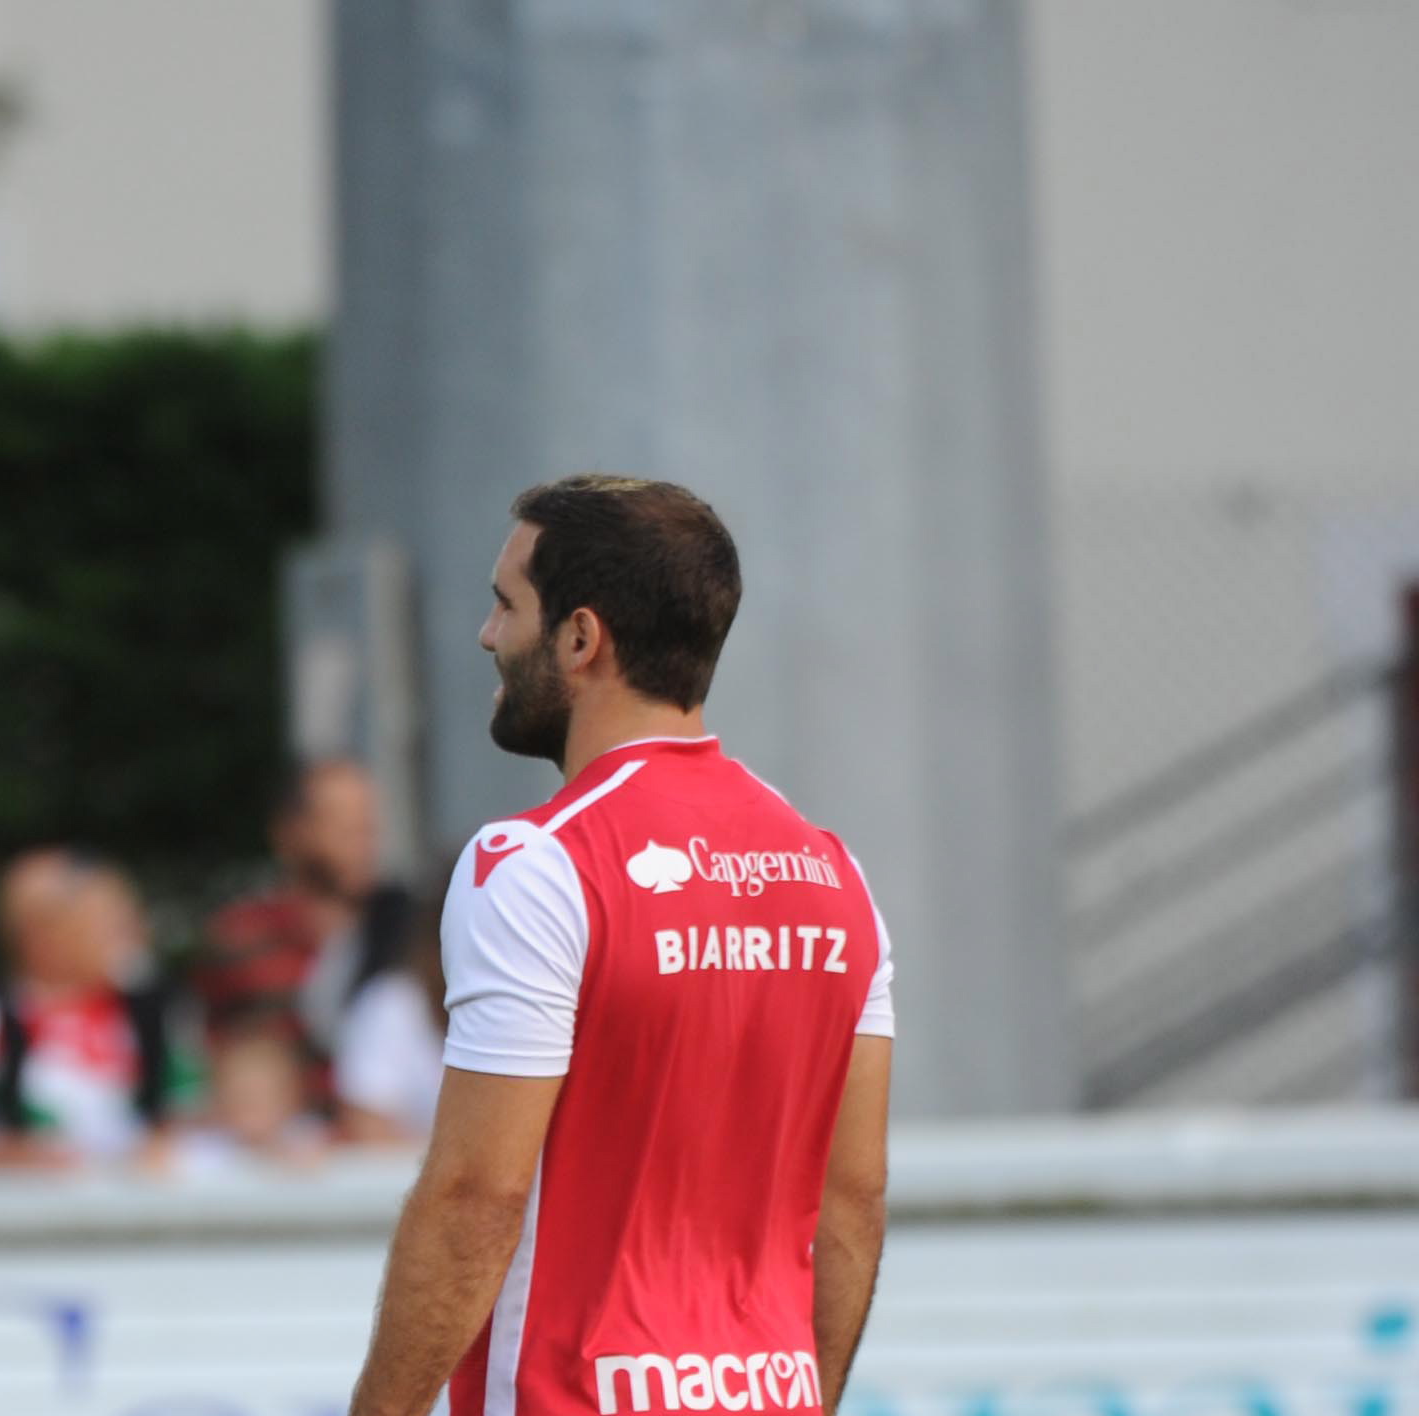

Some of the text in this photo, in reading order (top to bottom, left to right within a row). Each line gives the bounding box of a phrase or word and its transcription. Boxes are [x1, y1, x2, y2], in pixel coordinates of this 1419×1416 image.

[688, 836, 843, 897] Capgemini
[654, 925, 848, 975] BIARRITZ
[594, 1350, 822, 1416] macron
